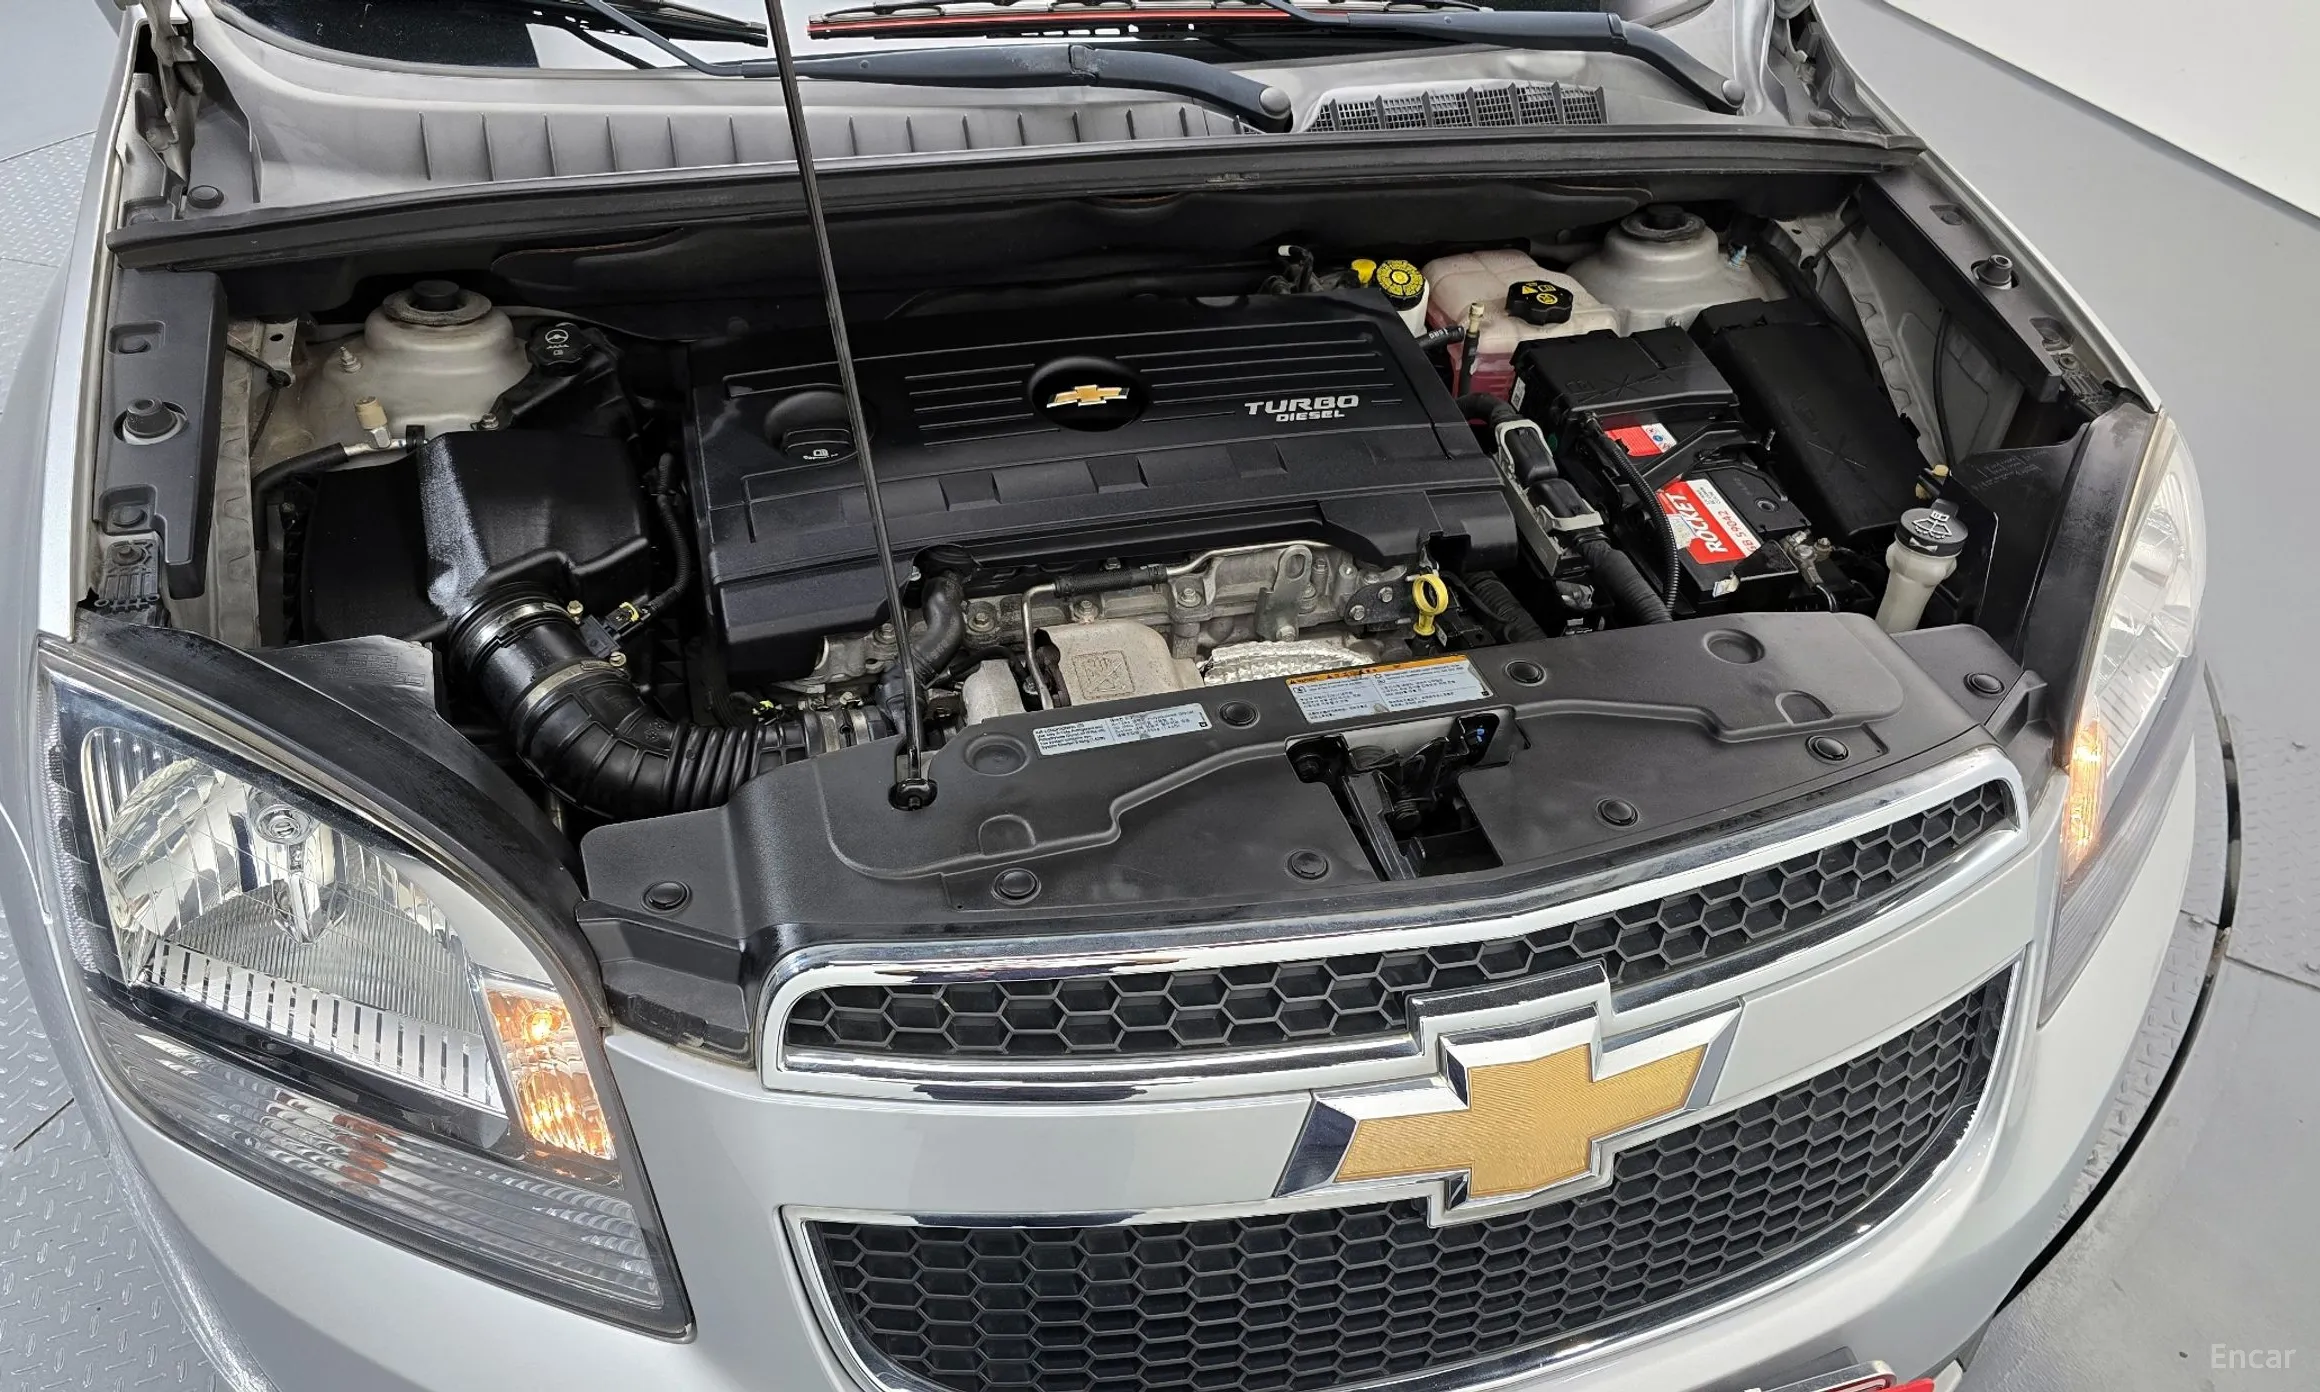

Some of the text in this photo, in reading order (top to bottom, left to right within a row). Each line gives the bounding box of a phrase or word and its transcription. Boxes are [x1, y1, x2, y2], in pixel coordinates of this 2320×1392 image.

[1245, 395, 1359, 415] TURBO
[1276, 411, 1345, 422] DIESEL
[1666, 494, 1728, 552] ROCKET
[1718, 510, 1747, 538] 59042
